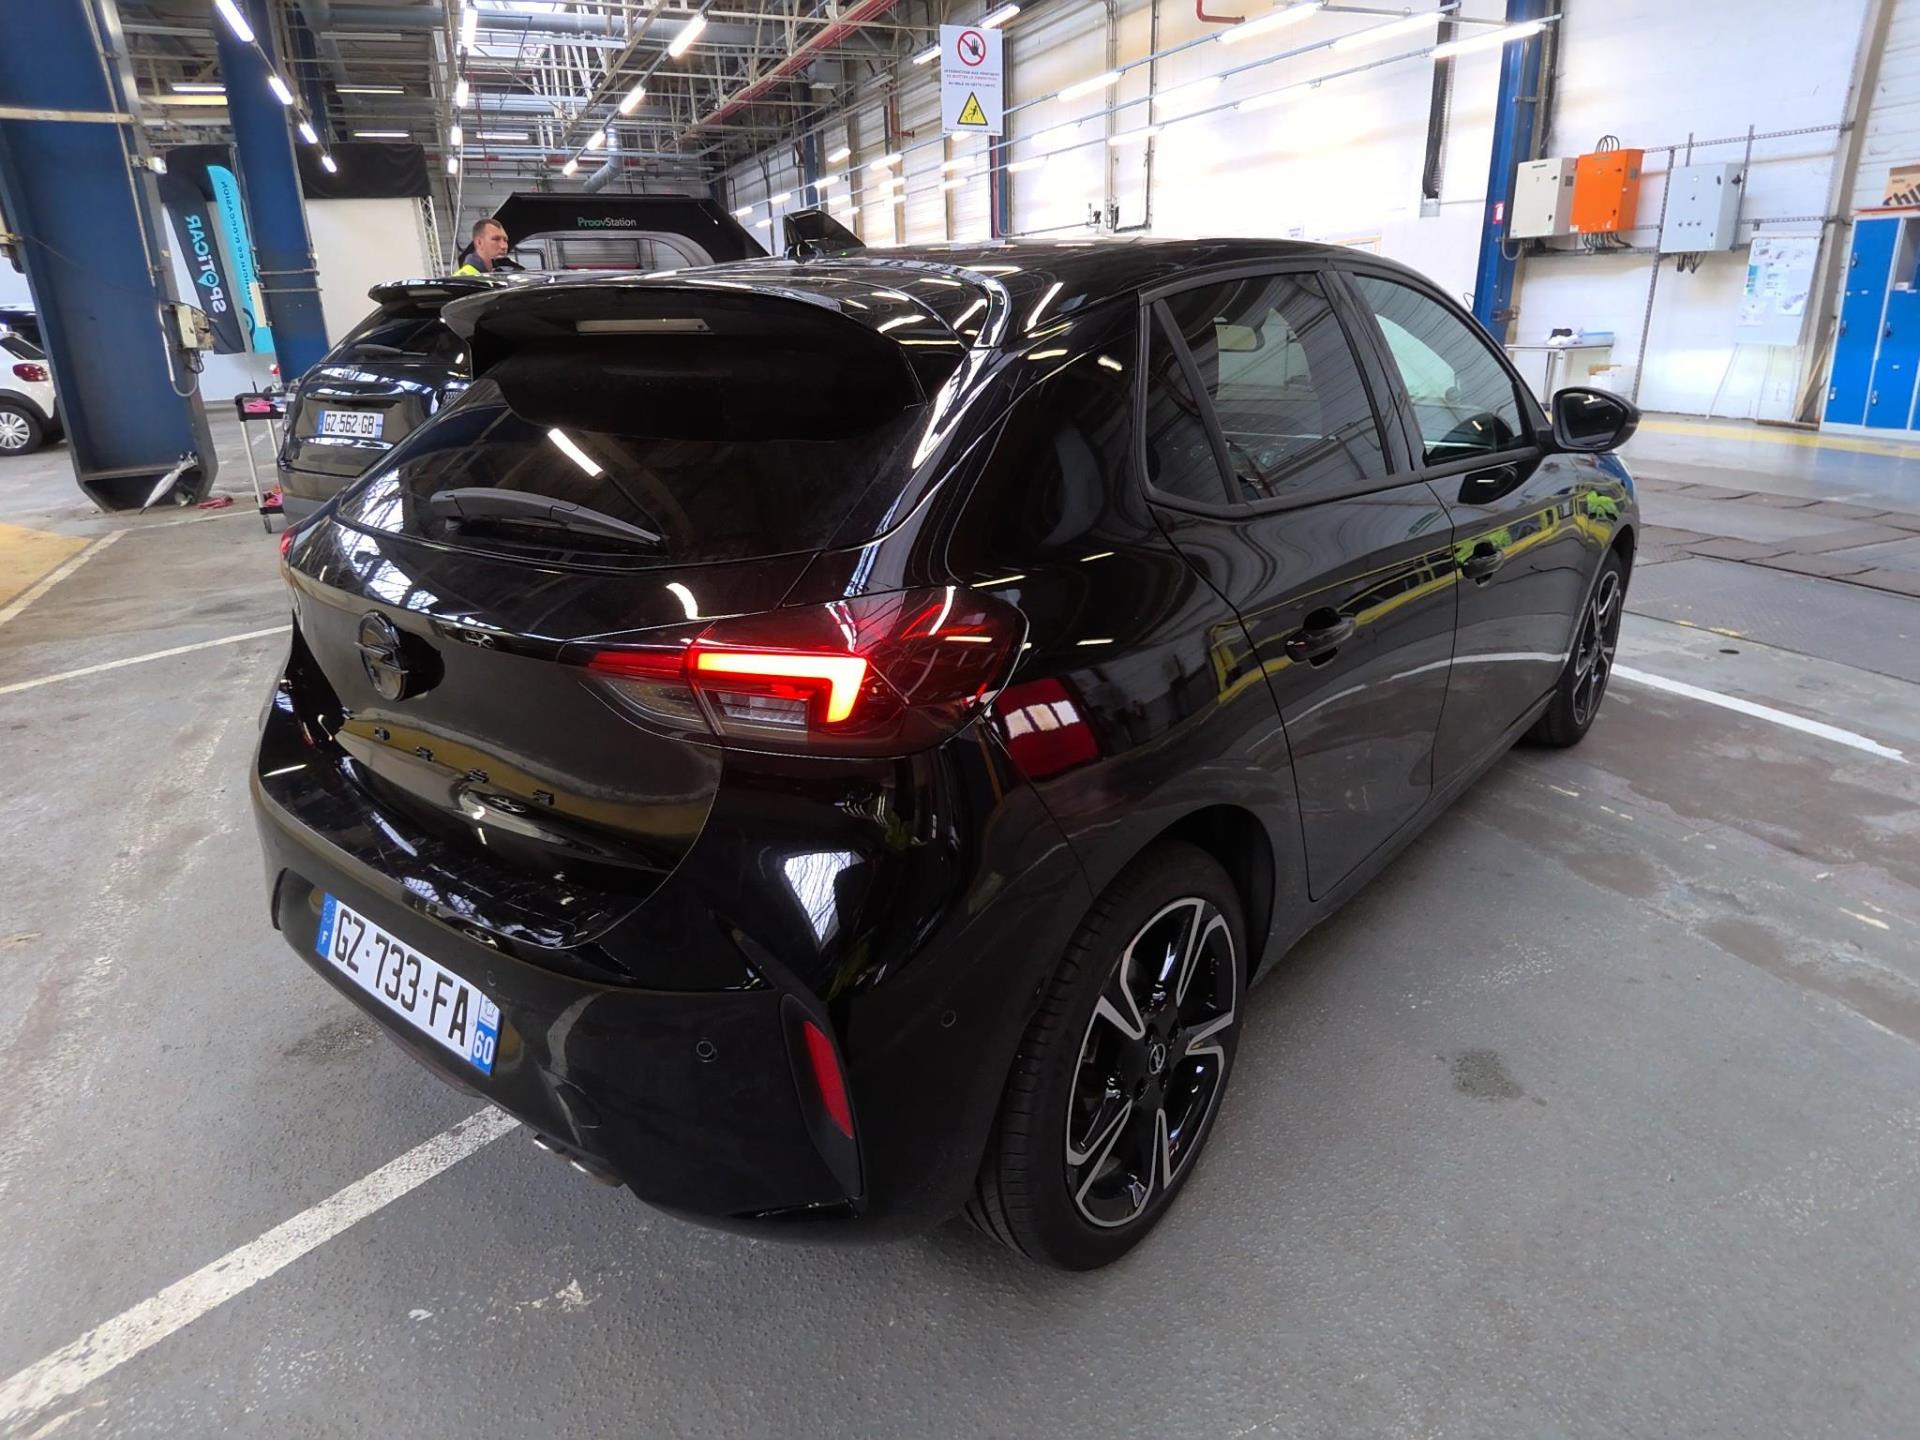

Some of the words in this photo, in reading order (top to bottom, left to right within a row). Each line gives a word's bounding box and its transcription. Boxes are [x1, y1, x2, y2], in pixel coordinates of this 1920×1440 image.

[577, 216, 637, 227] ProovStation
[334, 908, 470, 1047] GZ-733-FA
[472, 1030, 495, 1065] 60
